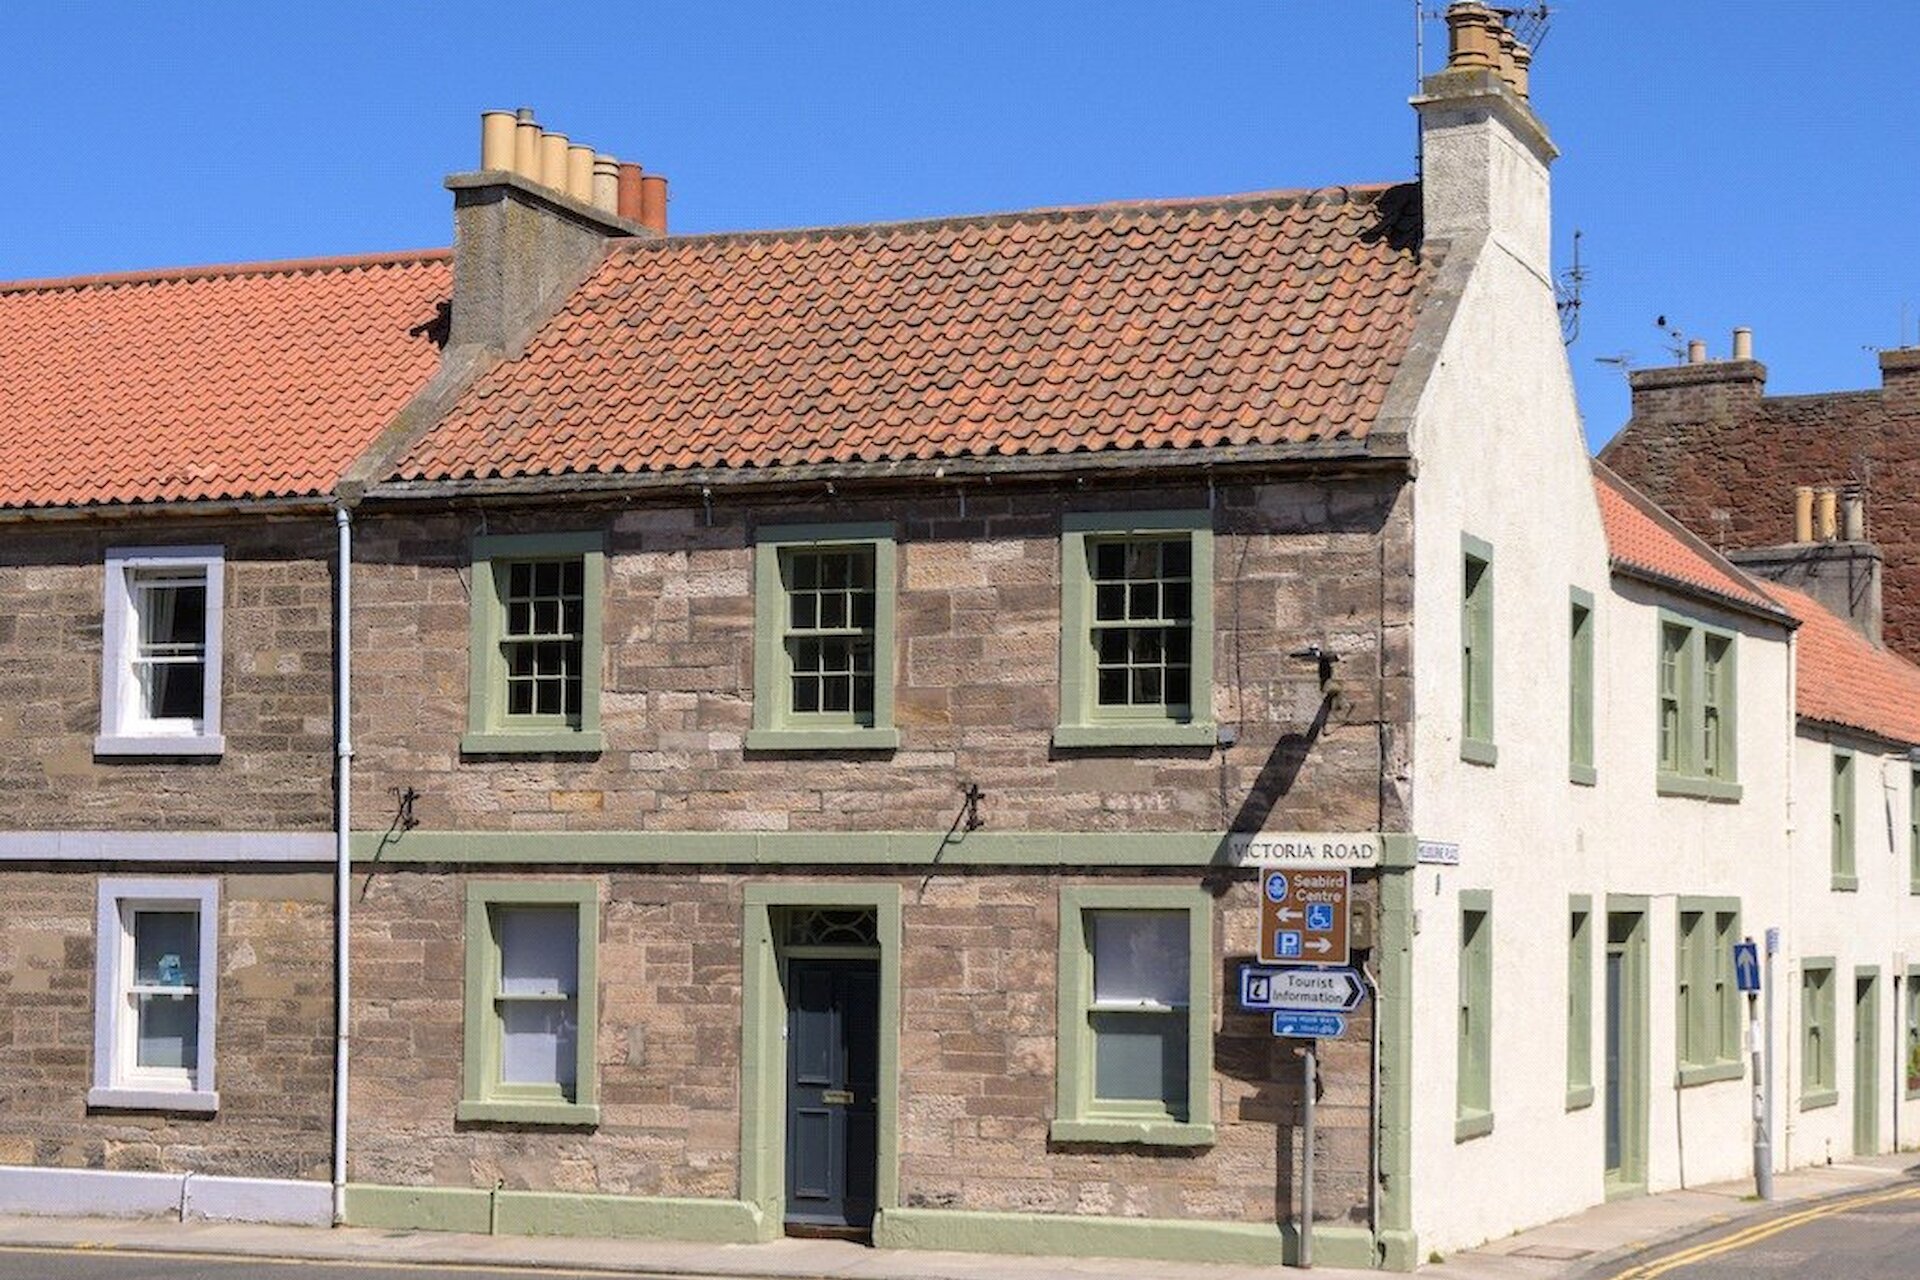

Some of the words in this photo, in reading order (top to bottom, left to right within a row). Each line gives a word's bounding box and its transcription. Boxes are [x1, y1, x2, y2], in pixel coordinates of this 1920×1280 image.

[1234, 844, 1314, 859] VICTORIA
[1322, 844, 1374, 859] ROAD
[1293, 874, 1345, 888] Seabird
[1295, 889, 1342, 903] Centre
[1281, 933, 1298, 955] P
[1288, 975, 1334, 989] Tourist
[1272, 989, 1343, 1004] Information
